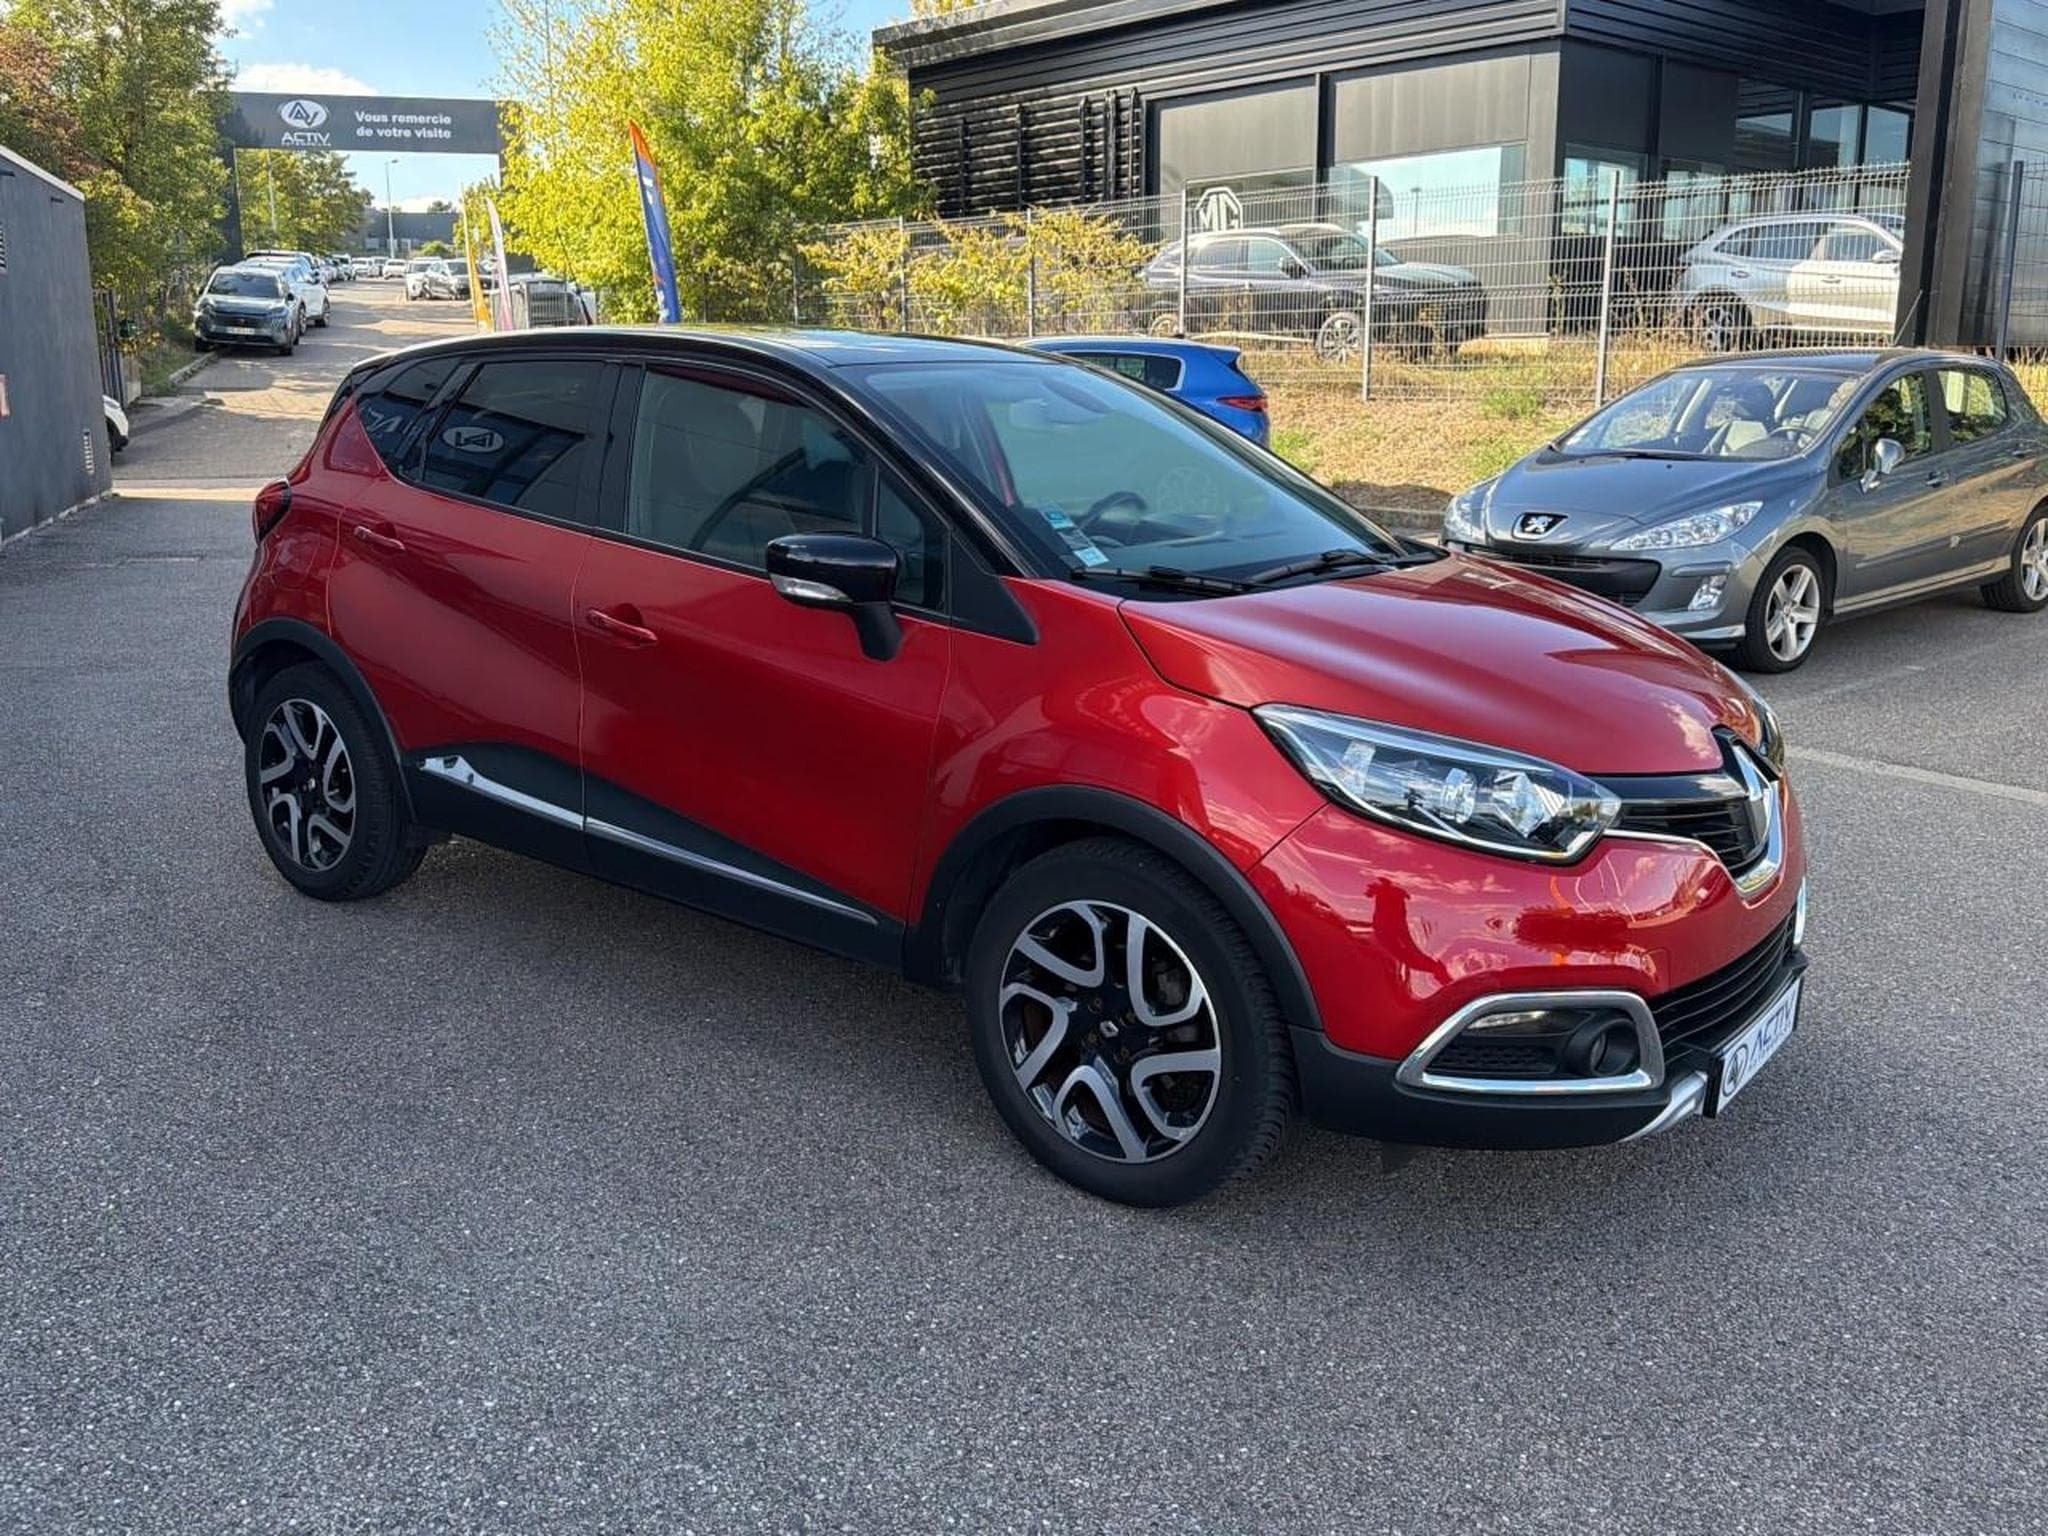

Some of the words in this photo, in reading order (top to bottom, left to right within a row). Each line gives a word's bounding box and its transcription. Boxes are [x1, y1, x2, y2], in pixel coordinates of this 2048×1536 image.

[355, 111, 388, 123] Vous
[392, 111, 452, 125] remercie
[281, 131, 330, 143] ACTIV
[356, 126, 374, 137] de
[377, 127, 412, 138] votre
[414, 127, 452, 139] visite
[1198, 192, 1239, 231] MG
